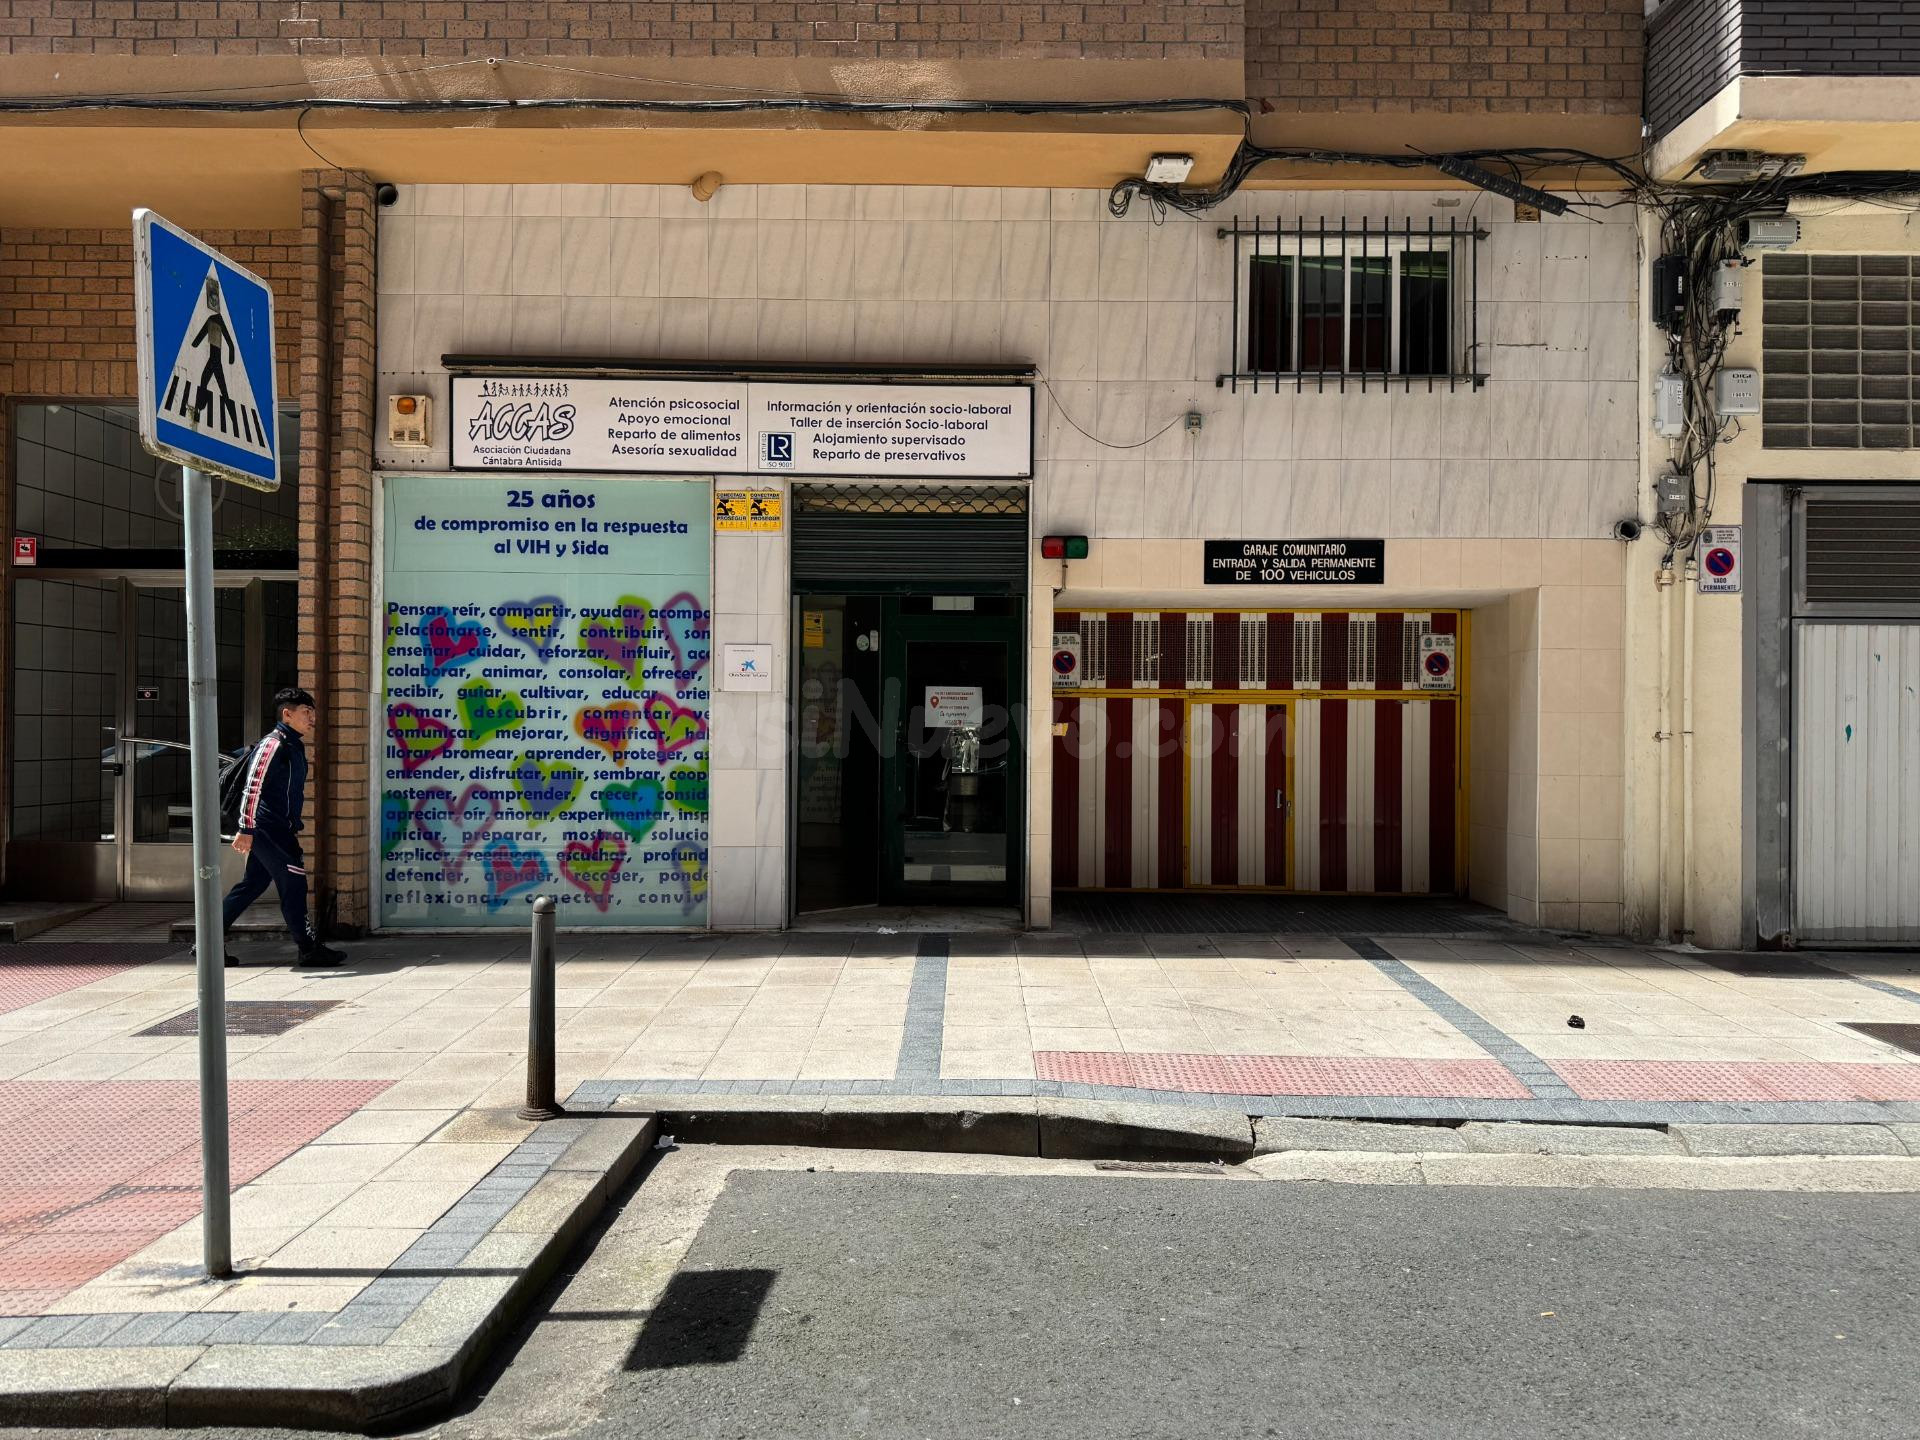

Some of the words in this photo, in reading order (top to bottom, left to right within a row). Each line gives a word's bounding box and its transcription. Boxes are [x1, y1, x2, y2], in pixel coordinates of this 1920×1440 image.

[609, 396, 665, 409] Atención
[669, 399, 740, 413] psicosocial
[767, 400, 841, 413] Información
[845, 405, 852, 416] y
[856, 402, 926, 414] orientación
[929, 403, 1012, 415] socio-laboral
[469, 400, 576, 442] ACCAS
[618, 413, 661, 428] Apoyo
[663, 414, 731, 426] emocional
[791, 417, 823, 428] Taller
[827, 418, 843, 428] de
[847, 418, 900, 429] inserción
[905, 419, 988, 430] Socio-laboral
[608, 429, 657, 443] Reparto
[660, 430, 677, 441] de
[680, 430, 741, 441] alimentos
[813, 433, 888, 446] Alojamiento
[891, 435, 966, 447] supervisado
[473, 444, 521, 455] Asociación
[524, 445, 571, 455] Ciudadana
[612, 444, 665, 456] Asesoría
[668, 445, 737, 457] sexualidad
[771, 436, 790, 458] LR
[482, 456, 523, 466] Cántabra
[525, 456, 562, 466] Antisida
[813, 449, 862, 462] Reparto
[865, 449, 881, 460] de
[884, 450, 966, 462] preservativos
[507, 490, 534, 508] 25
[542, 490, 595, 508] años
[414, 516, 436, 531] de
[441, 518, 549, 534] compromiso
[554, 521, 575, 532] en
[582, 518, 597, 532] la
[604, 520, 688, 535] respuesta
[494, 539, 511, 554] al
[517, 539, 549, 554] VIH
[556, 543, 567, 557] y
[573, 541, 609, 555] Sida
[1243, 544, 1278, 555] GARAJE
[1283, 544, 1346, 555] COMUNITARIO
[1212, 559, 1257, 568] ENTRADA
[1262, 559, 1268, 568] Y
[1272, 559, 1306, 568] SALIDA
[1311, 558, 1376, 568] PERMANENTE
[1235, 571, 1251, 580] DE
[1259, 569, 1285, 580] 100
[1290, 571, 1356, 580] VEHICULOS
[387, 602, 448, 617] Pensar,
[453, 602, 486, 617] reír,
[489, 605, 576, 619] compartir,
[580, 605, 645, 620] ayudar,
[387, 623, 497, 639] relacionarse,
[512, 626, 565, 639] sentir,
[580, 626, 669, 640] contribuir,
[387, 644, 456, 659] enseñar,
[468, 644, 525, 659] cuidar,
[538, 645, 609, 660] reforzar,
[622, 646, 674, 661] influir,
[387, 664, 471, 679] colaborar,
[482, 665, 547, 680] animar,
[559, 666, 630, 680] consolar,
[642, 666, 702, 681] ofrecer,
[387, 684, 444, 699] recibir,
[457, 686, 506, 700] guiar,
[520, 685, 588, 700] cultivar,
[387, 704, 458, 719] formar,
[474, 705, 568, 720] descubrir,
[387, 726, 480, 740] comunicar,
[496, 727, 568, 741] mejorar,
[583, 727, 670, 741] dignificar,
[387, 746, 434, 760] llorar,
[443, 747, 518, 760] bromear,
[525, 747, 606, 762] aprender,
[613, 748, 687, 763] proteger,
[386, 766, 465, 781] entender,
[469, 766, 547, 781] disfrutar,
[551, 767, 588, 781] unir,
[593, 767, 665, 781] sembrar,
[387, 788, 457, 801] sostener,
[472, 787, 576, 802] comprender,
[590, 791, 643, 802] crecer,
[386, 808, 460, 822] apreciar,
[464, 807, 490, 822] oír,
[495, 808, 555, 822] añorar,
[559, 808, 675, 823] experimentar,
[387, 829, 447, 842] iniciar,
[463, 831, 547, 843] preparar,
[563, 830, 636, 842] mostrar,
[652, 828, 708, 840] solucio
[386, 848, 456, 863] explicar,
[557, 848, 632, 862] escuchar,
[644, 848, 708, 863] profund
[385, 868, 469, 883] defender,
[484, 869, 559, 883] atender,
[575, 872, 644, 883] recoger,
[385, 891, 508, 905] reflexionar,
